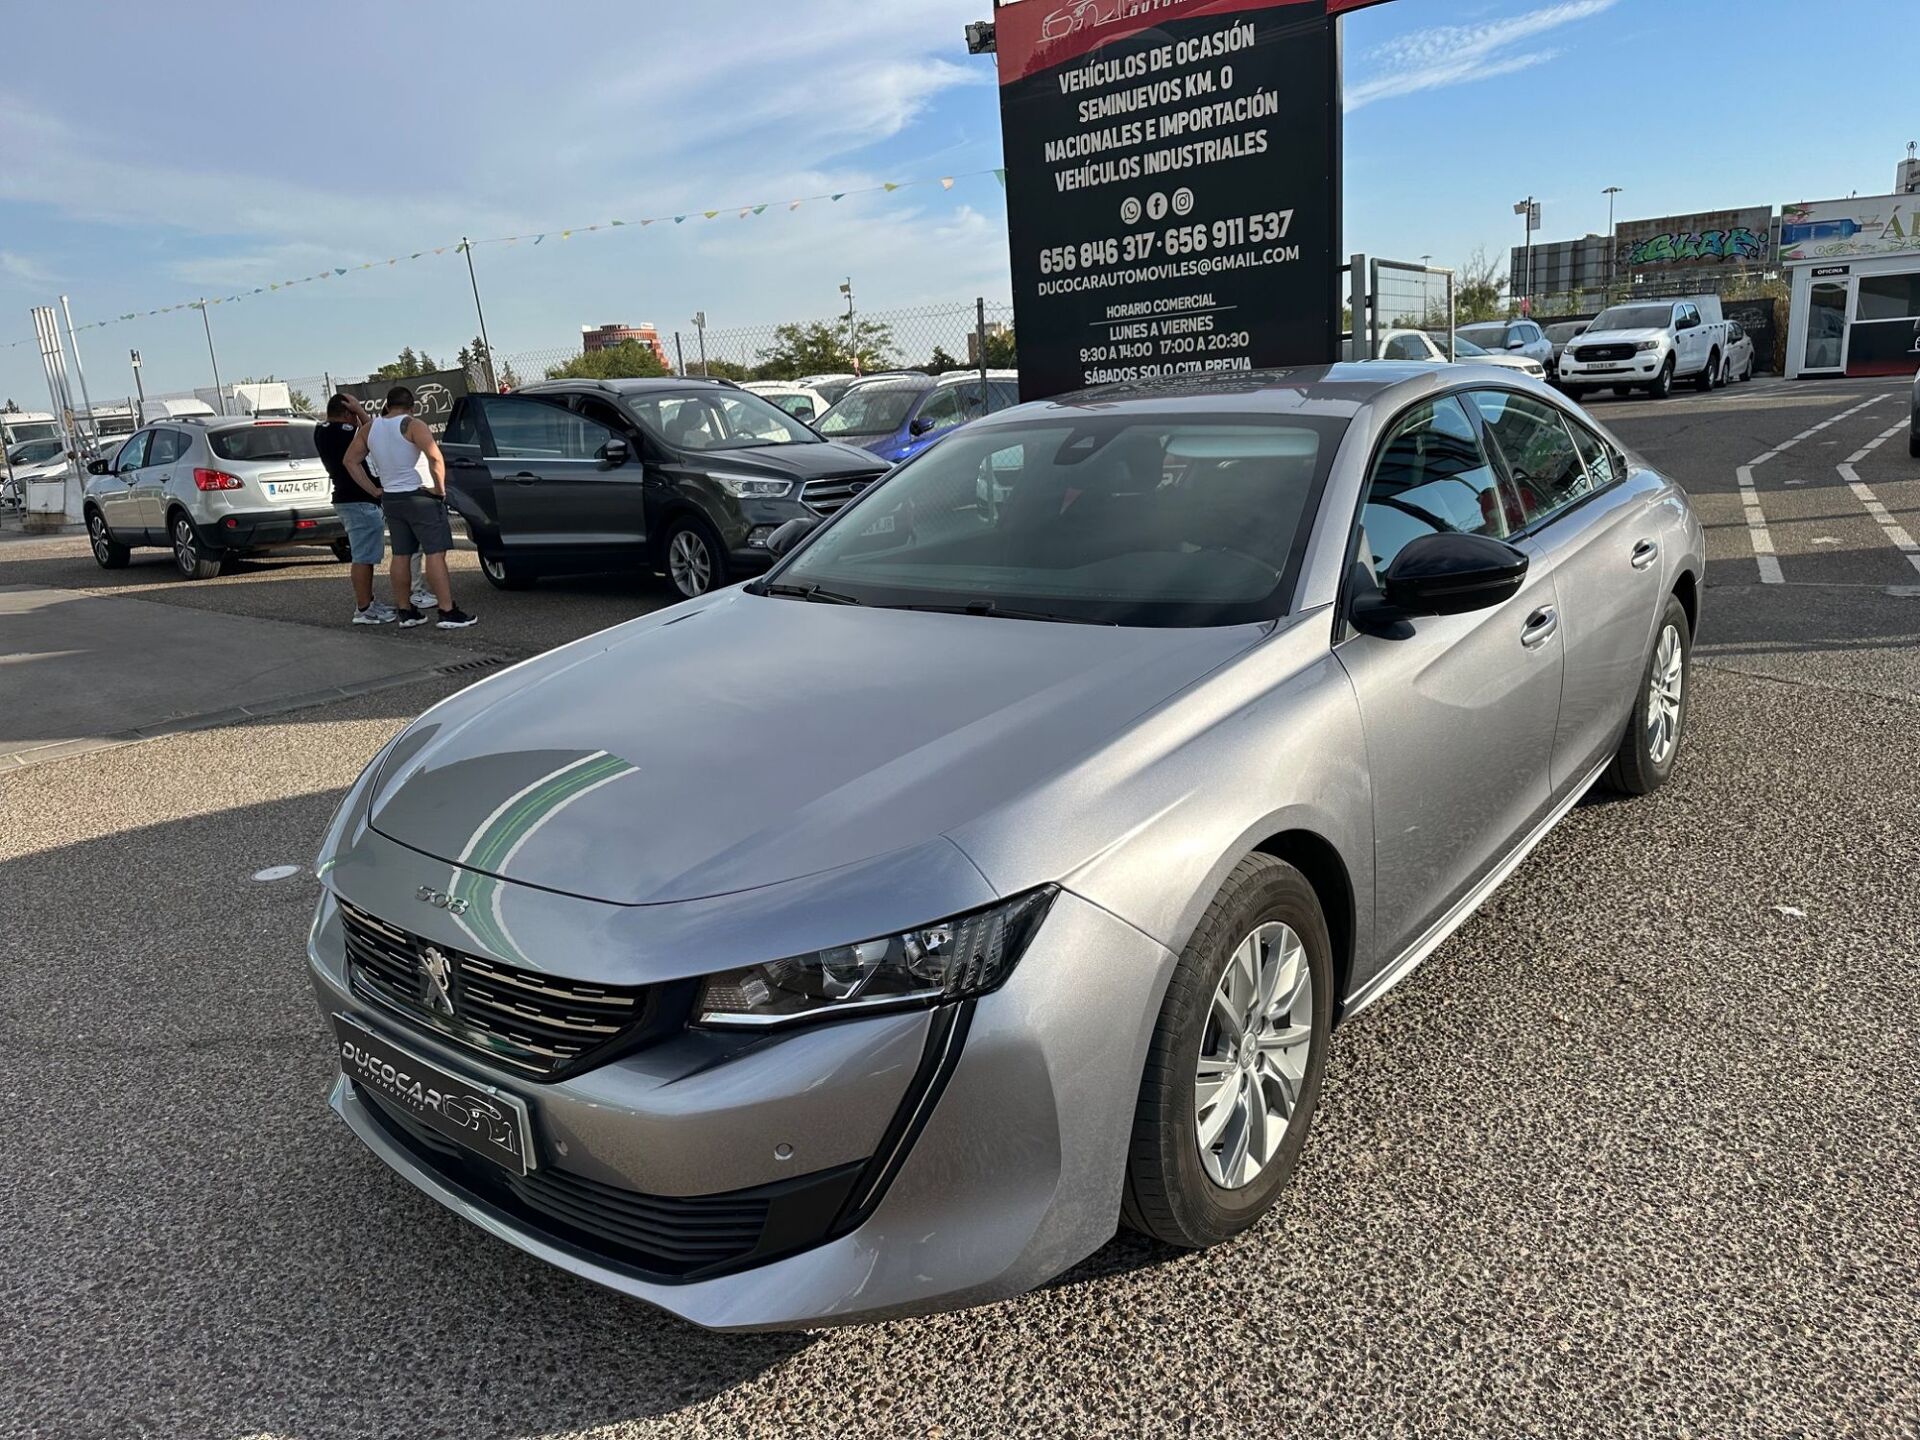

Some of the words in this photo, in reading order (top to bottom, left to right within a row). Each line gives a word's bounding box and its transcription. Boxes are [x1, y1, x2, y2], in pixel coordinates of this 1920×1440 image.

[1059, 59, 1146, 94] VEHÍCULOS
[1150, 45, 1172, 71] DE
[1176, 19, 1255, 65] OCASIÓN
[1079, 78, 1181, 122] SEMINUEVOS
[1186, 71, 1216, 98] KM.
[1045, 121, 1142, 162] NACIONALES
[1145, 118, 1156, 141] E
[1159, 87, 1278, 138] IMPORTACIÓN
[1055, 160, 1140, 192] VEHÍCULOS
[1144, 129, 1268, 175] INDUSTRIALES
[1039, 245, 1076, 274] 656
[1080, 238, 1118, 268] 846
[1212, 217, 1244, 248] 911
[1249, 209, 1294, 243] 537
[1038, 245, 1299, 296] DUCOCARAUTOMOVILES@GMAIL.COM
[1817, 267, 1843, 276] OFICINA
[1107, 301, 1151, 319] HORARIO
[1153, 293, 1216, 313] COMERCIAL
[1110, 323, 1148, 341] LUNES
[1150, 322, 1159, 337] A
[1160, 315, 1214, 335] VIERNES
[1080, 347, 1107, 362] 9:30
[1109, 346, 1117, 360] A
[1118, 342, 1152, 359] 14:00
[1160, 337, 1194, 354] 17:00
[1196, 336, 1206, 351] A
[1208, 331, 1249, 350] 20:30
[1084, 366, 1138, 385] SÁBADOS
[278, 483, 300, 494] 4474
[302, 481, 319, 492] GPF
[415, 885, 470, 916] 508
[342, 1041, 443, 1111] DUCOCAR
[357, 1067, 424, 1111] AUTOMOVILES
